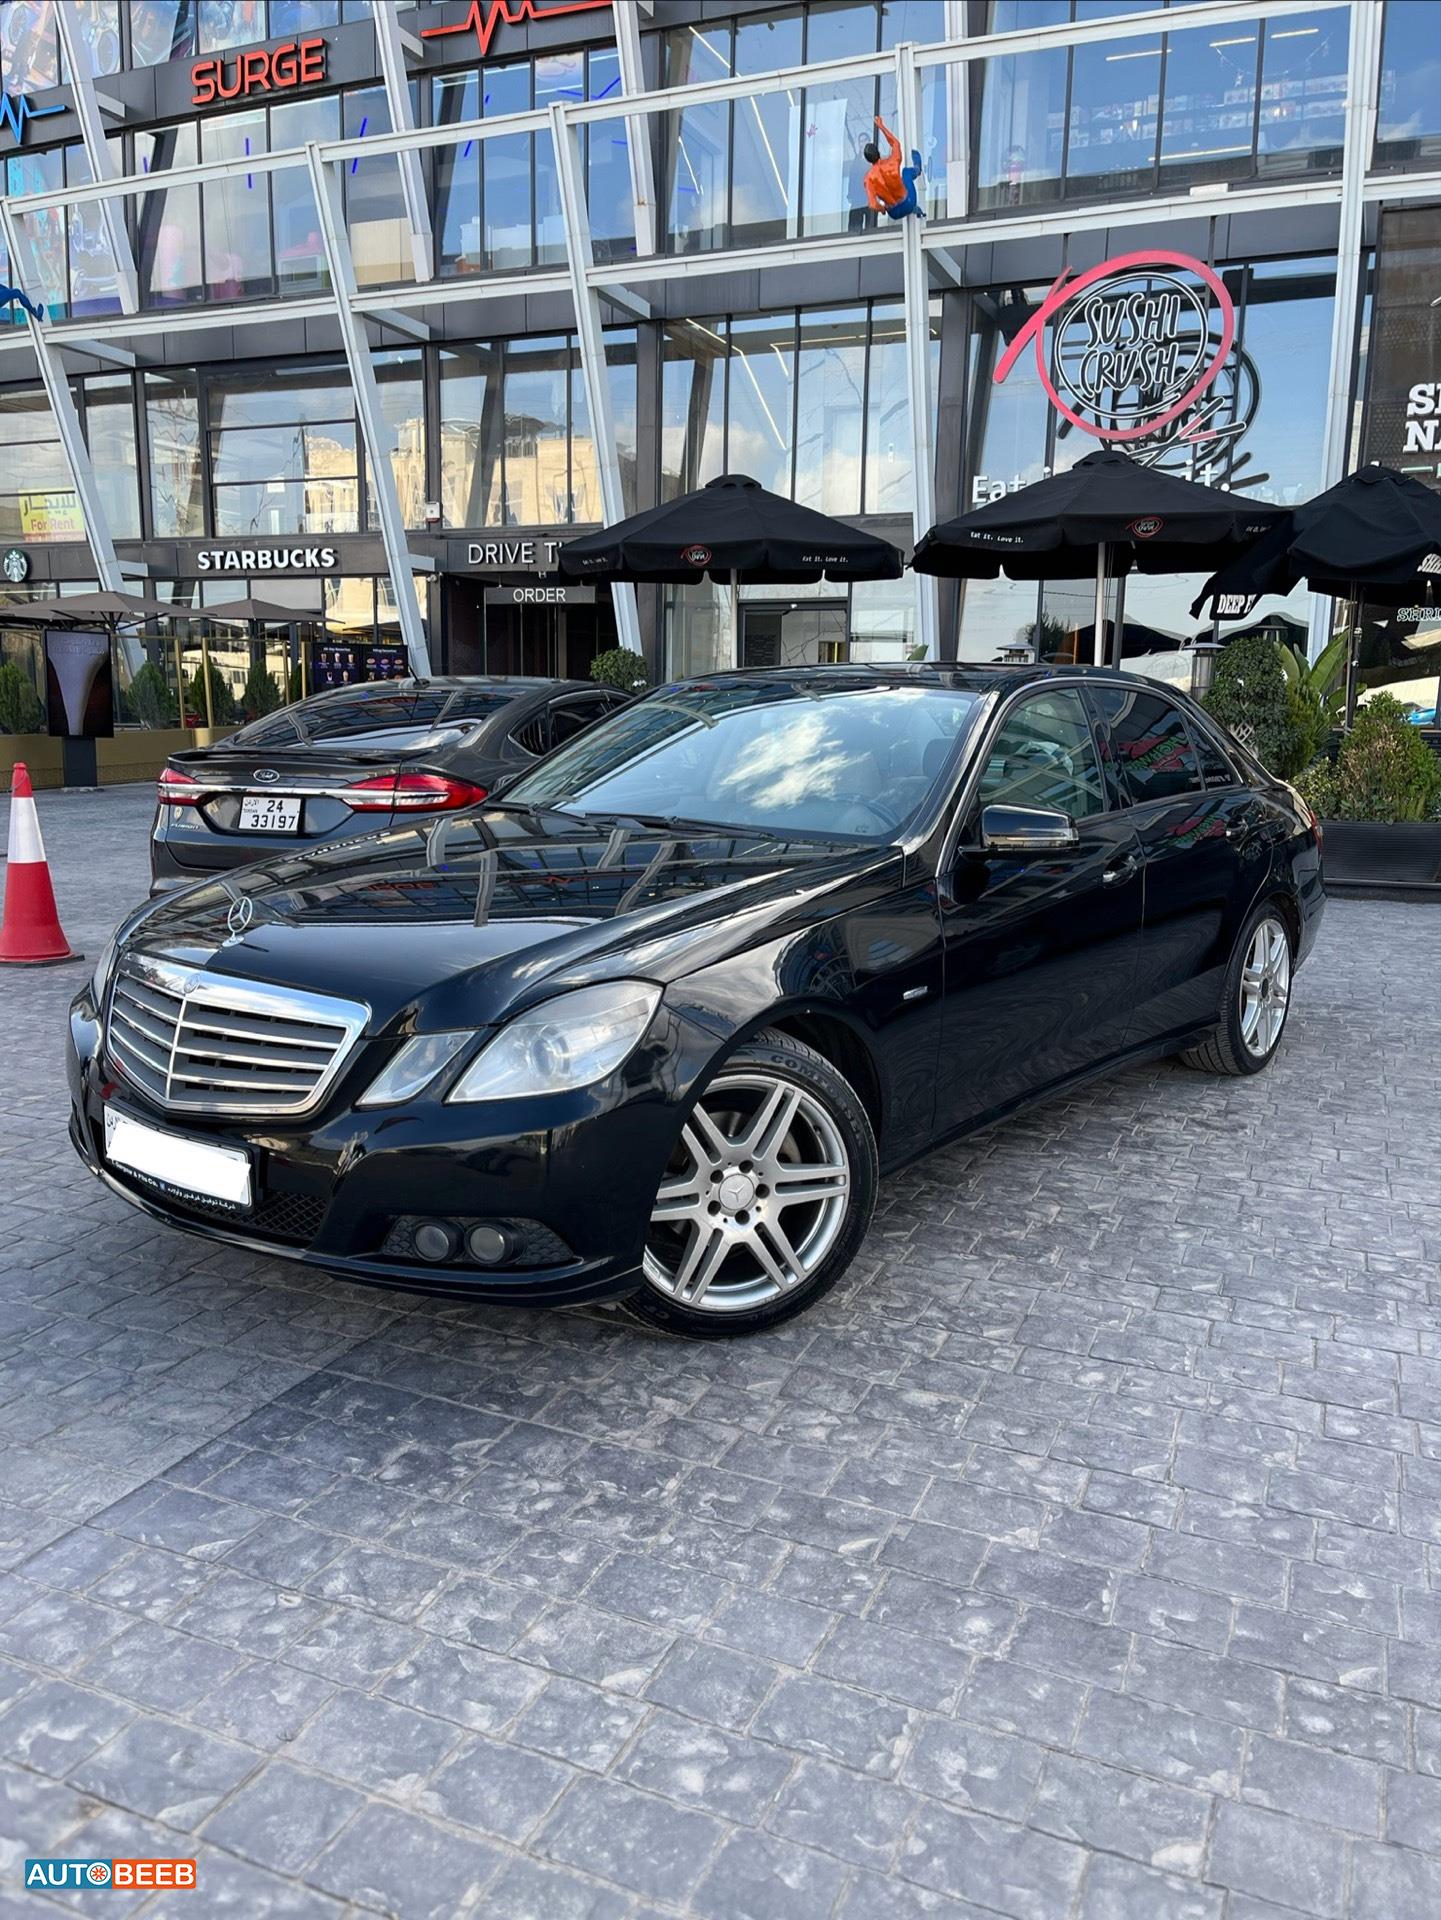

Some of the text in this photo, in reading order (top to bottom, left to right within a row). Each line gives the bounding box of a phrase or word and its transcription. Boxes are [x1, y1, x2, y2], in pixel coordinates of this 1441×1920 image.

[191, 38, 326, 105] SURGE
[1084, 292, 1181, 349] SUSHI
[1080, 342, 1179, 398] CRUSH
[972, 474, 1026, 503] Eat
[31, 518, 76, 531] For Rent
[197, 547, 336, 571] STARBUCKS
[469, 542, 534, 565] DRIVE
[544, 541, 563, 564] T
[512, 587, 567, 603] ORDER
[1216, 594, 1246, 614] DEEP
[266, 799, 284, 813] 24
[251, 814, 297, 829] 33197
